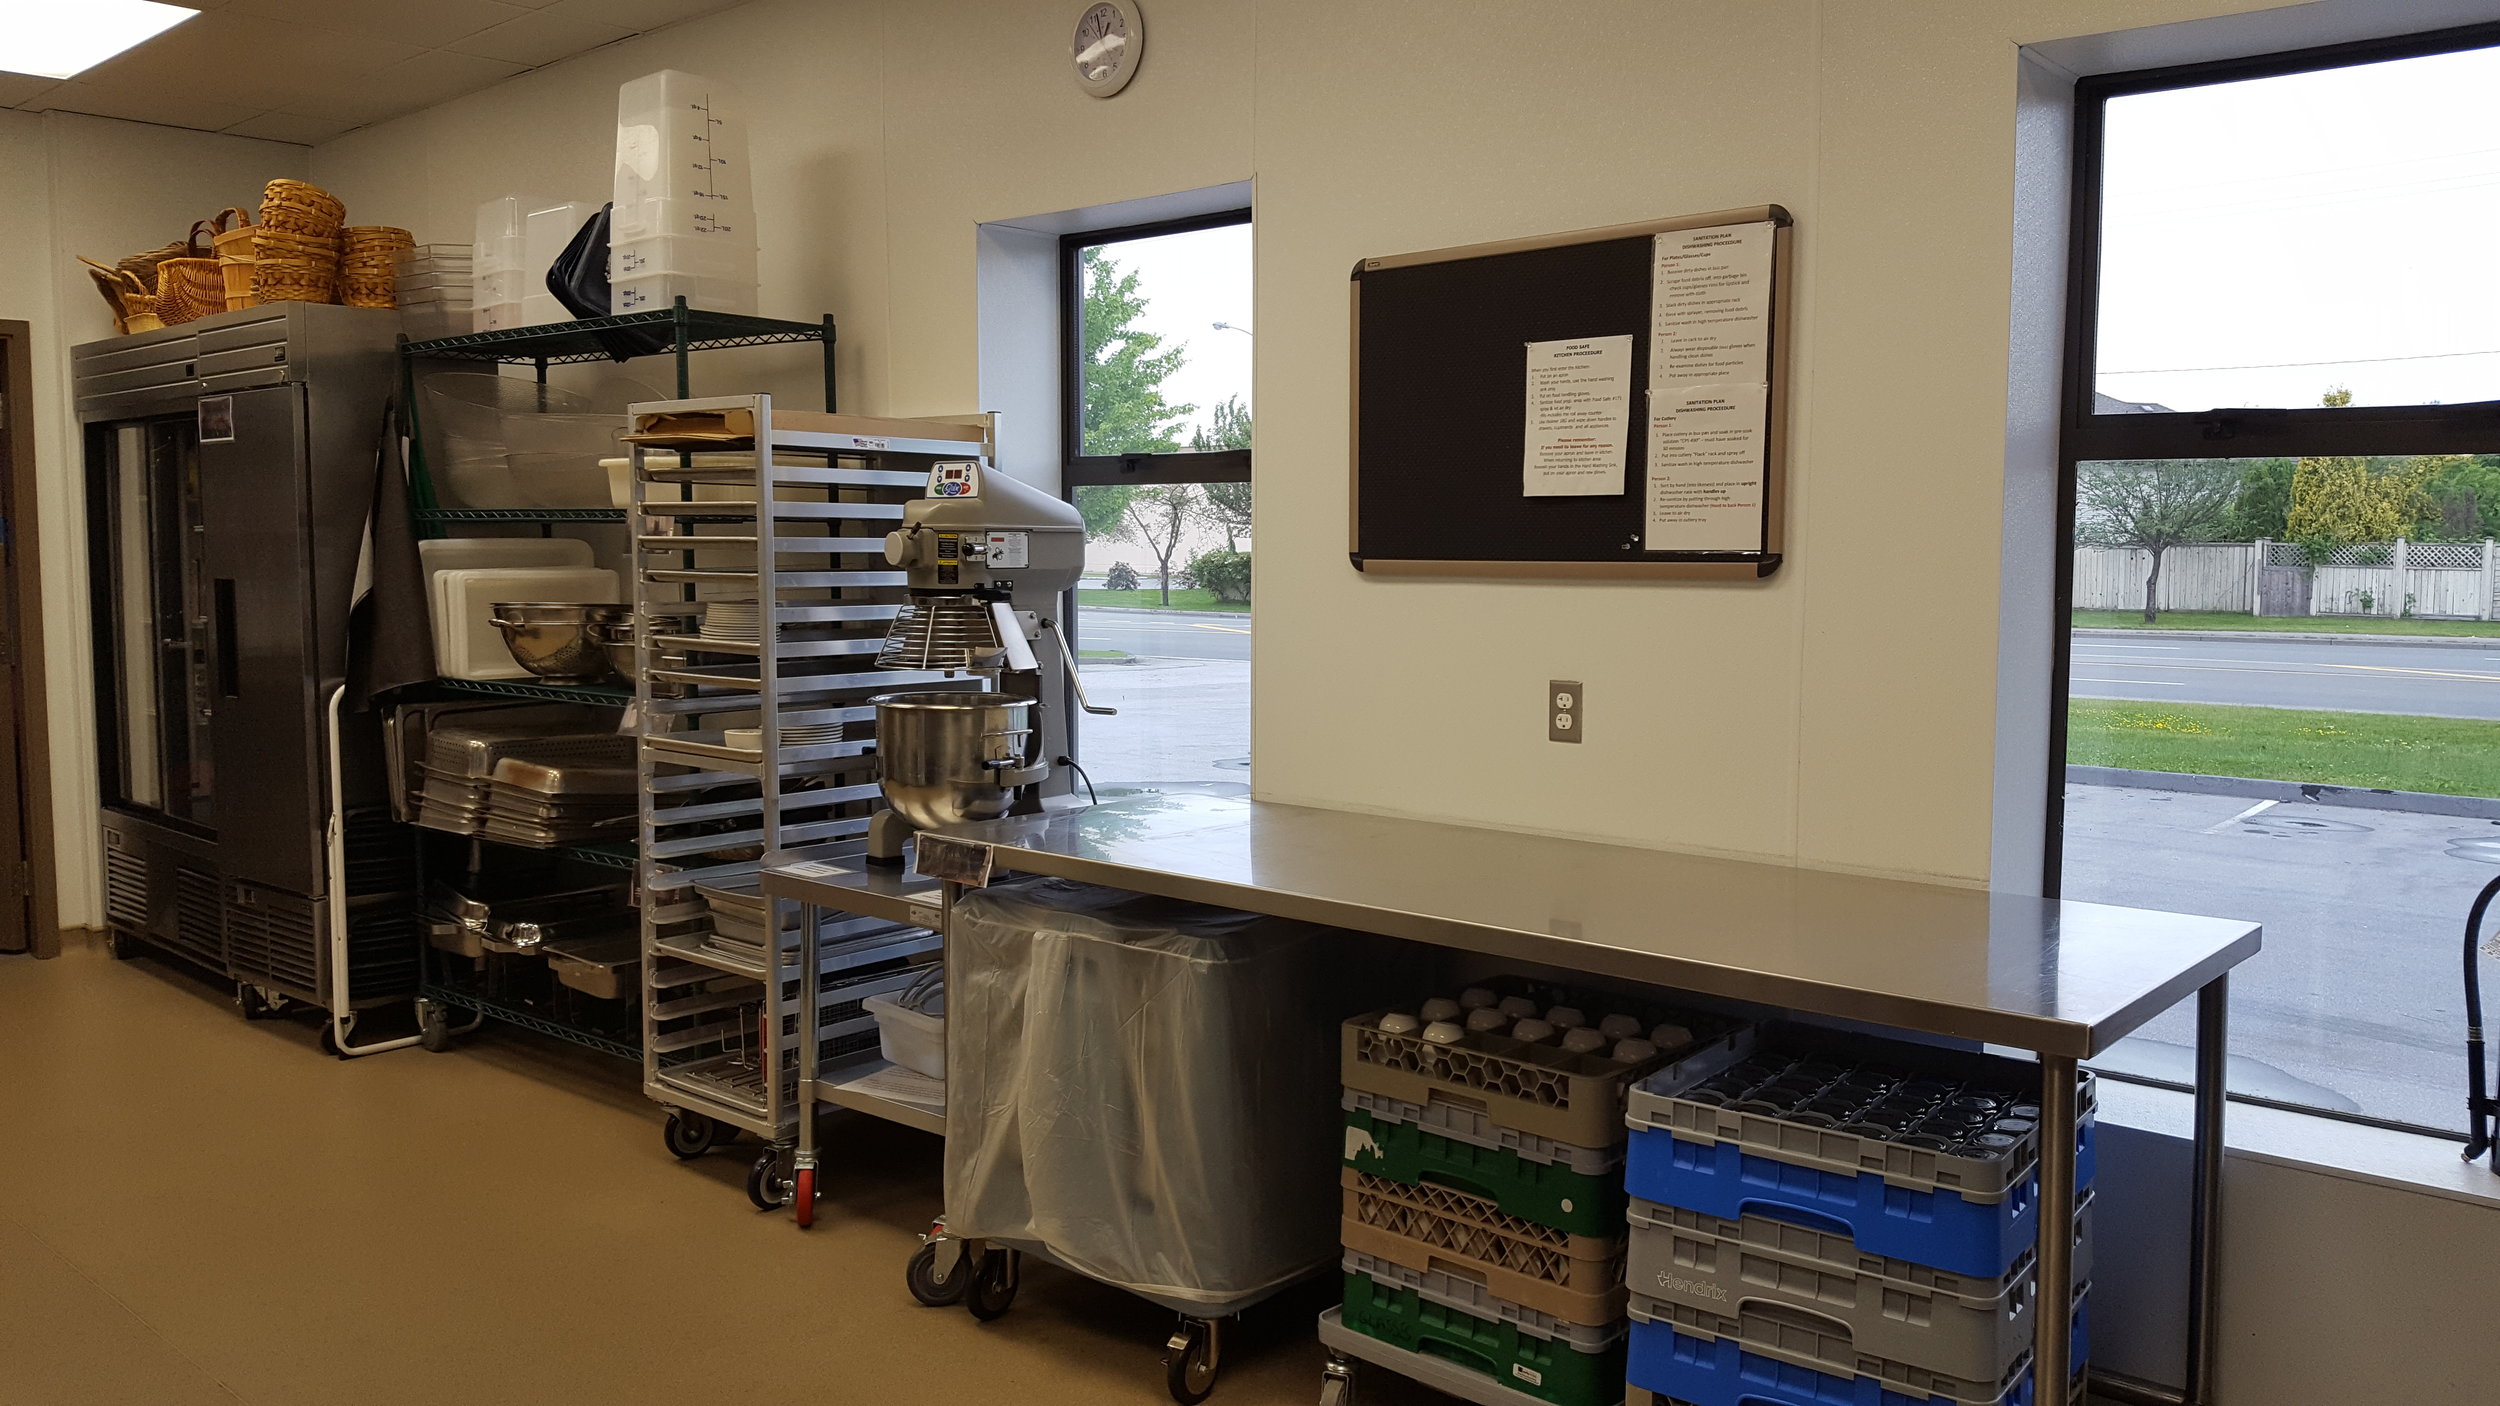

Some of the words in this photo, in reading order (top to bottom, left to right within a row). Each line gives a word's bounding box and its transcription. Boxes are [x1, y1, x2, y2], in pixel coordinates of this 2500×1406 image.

[1100, 8, 1107, 17] 12
[1090, 16, 1098, 24] 11
[1120, 18, 1124, 28] 2
[1082, 28, 1089, 37] 10
[1657, 1271, 1727, 1302] Hendrix
